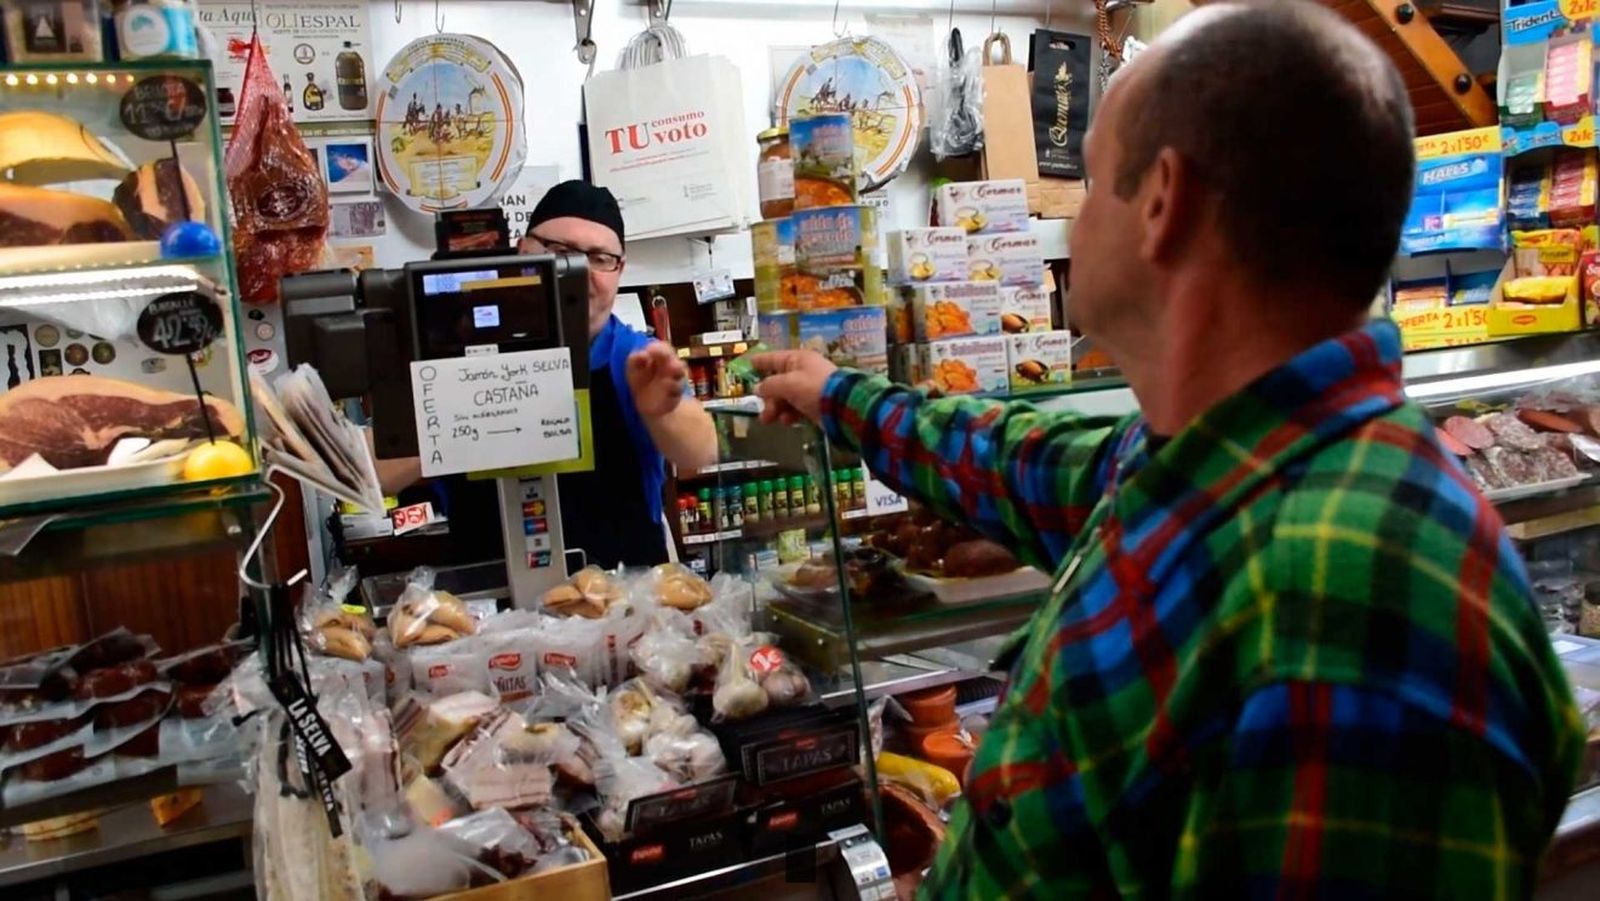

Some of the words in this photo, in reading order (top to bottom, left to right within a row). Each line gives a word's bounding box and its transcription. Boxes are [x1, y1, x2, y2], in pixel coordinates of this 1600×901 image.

[266, 13, 361, 28] OLIESPAL
[1511, 10, 1556, 31] Trident
[651, 110, 705, 128] consumo
[605, 122, 650, 155] TU
[653, 122, 708, 144] voto
[1423, 162, 1467, 185] HALLS
[1398, 313, 1439, 328] OFERTA
[532, 358, 570, 374] SELVA
[473, 380, 539, 407] CASTAÑA
[452, 425, 479, 442] 250g
[875, 494, 903, 508] VISA
[288, 697, 308, 720] LA
[298, 712, 332, 757] SELVA
